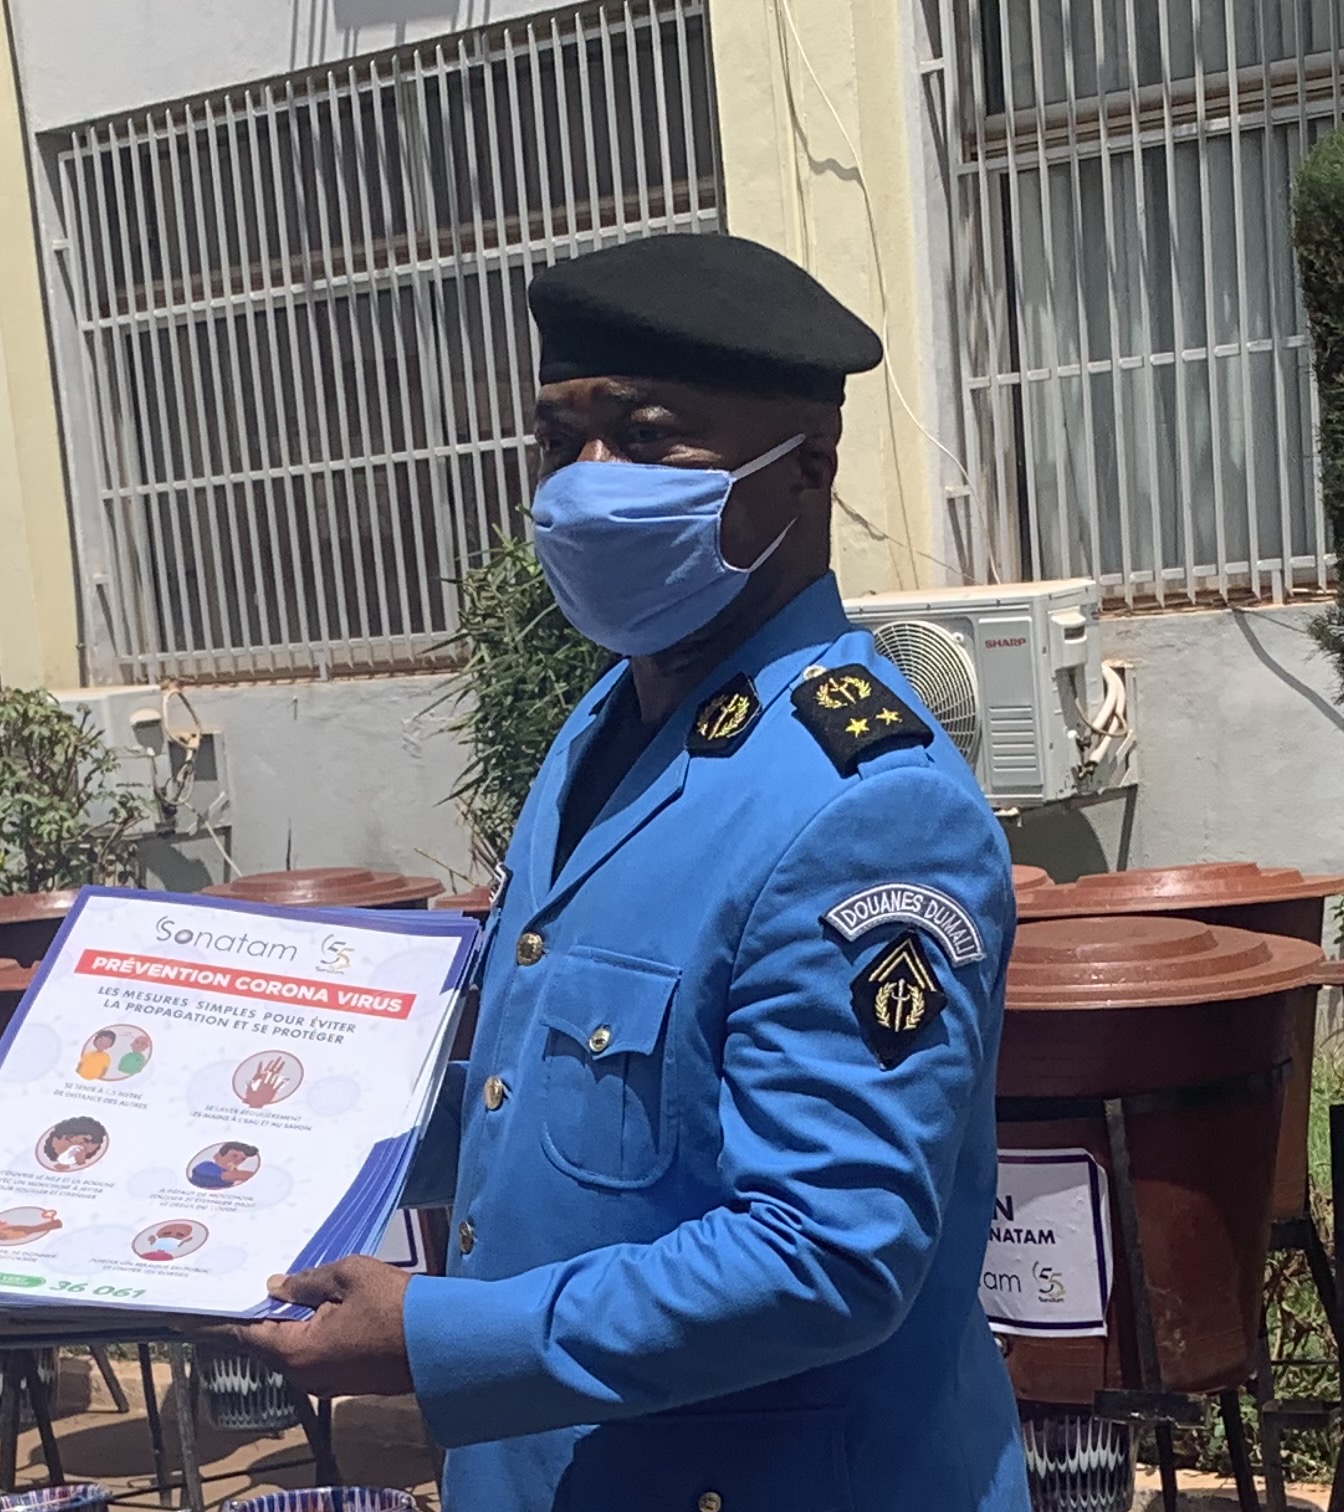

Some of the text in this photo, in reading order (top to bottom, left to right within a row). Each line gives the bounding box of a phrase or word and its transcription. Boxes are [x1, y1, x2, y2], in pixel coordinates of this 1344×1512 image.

[985, 637, 1026, 649] SHARP
[841, 890, 924, 928] DOUANES
[155, 915, 298, 962] Sonatam
[91, 956, 403, 1014] PRÉVENTION CORONA VIRUS
[98, 985, 356, 1034] LES MESURES SIMPLES POUR ÉVITER
[103, 999, 345, 1045] LA PROPAGATION ET SE PROTÉGER
[989, 1227, 1056, 1245] NATAM
[49, 1281, 89, 1293] 36
[92, 1285, 147, 1299] 061
